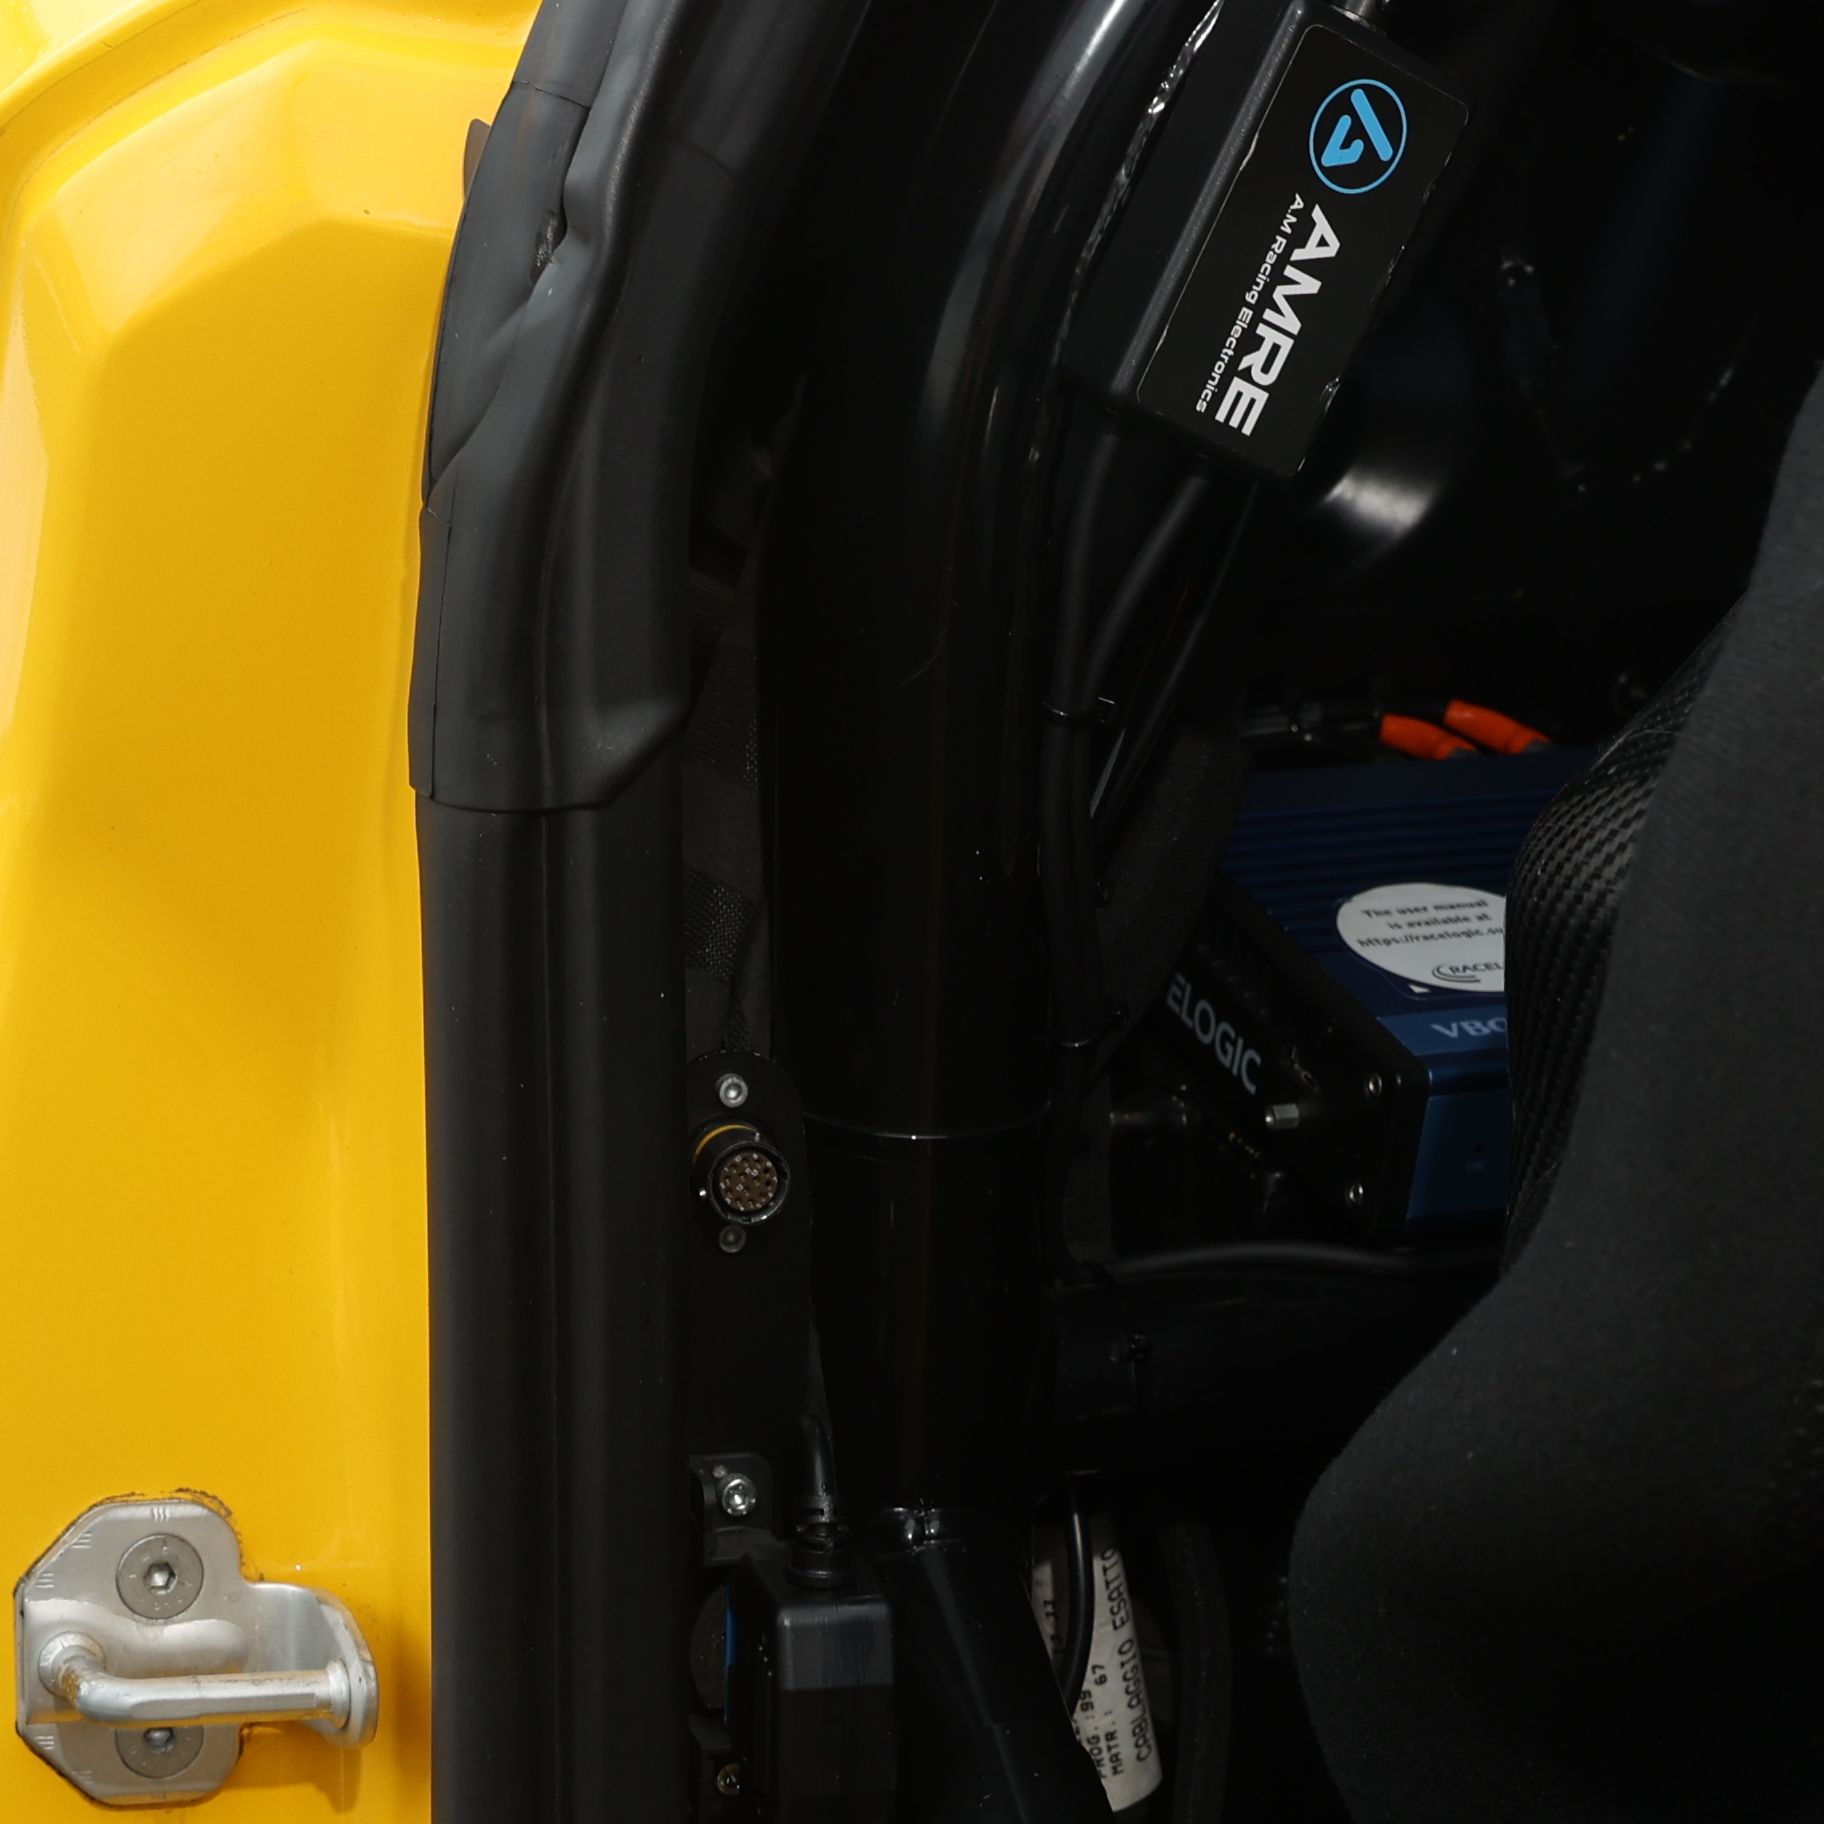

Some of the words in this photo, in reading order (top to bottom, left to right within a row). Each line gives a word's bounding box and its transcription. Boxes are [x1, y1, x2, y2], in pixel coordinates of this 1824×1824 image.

[1245, 235, 1285, 305] Racing
[1195, 305, 1254, 414] Electronics
[1214, 203, 1341, 436] AMRE
[1361, 909, 1392, 919] The
[1396, 907, 1428, 915] user
[1433, 900, 1489, 912] manual
[1387, 921, 1402, 930] is
[1407, 916, 1471, 928] available
[1475, 913, 1492, 921] at
[1165, 972, 1263, 1096] ELOGIC
[1101, 1546, 1130, 1630] ESATTO
[1118, 1638, 1152, 1763] CABLAGGIO
